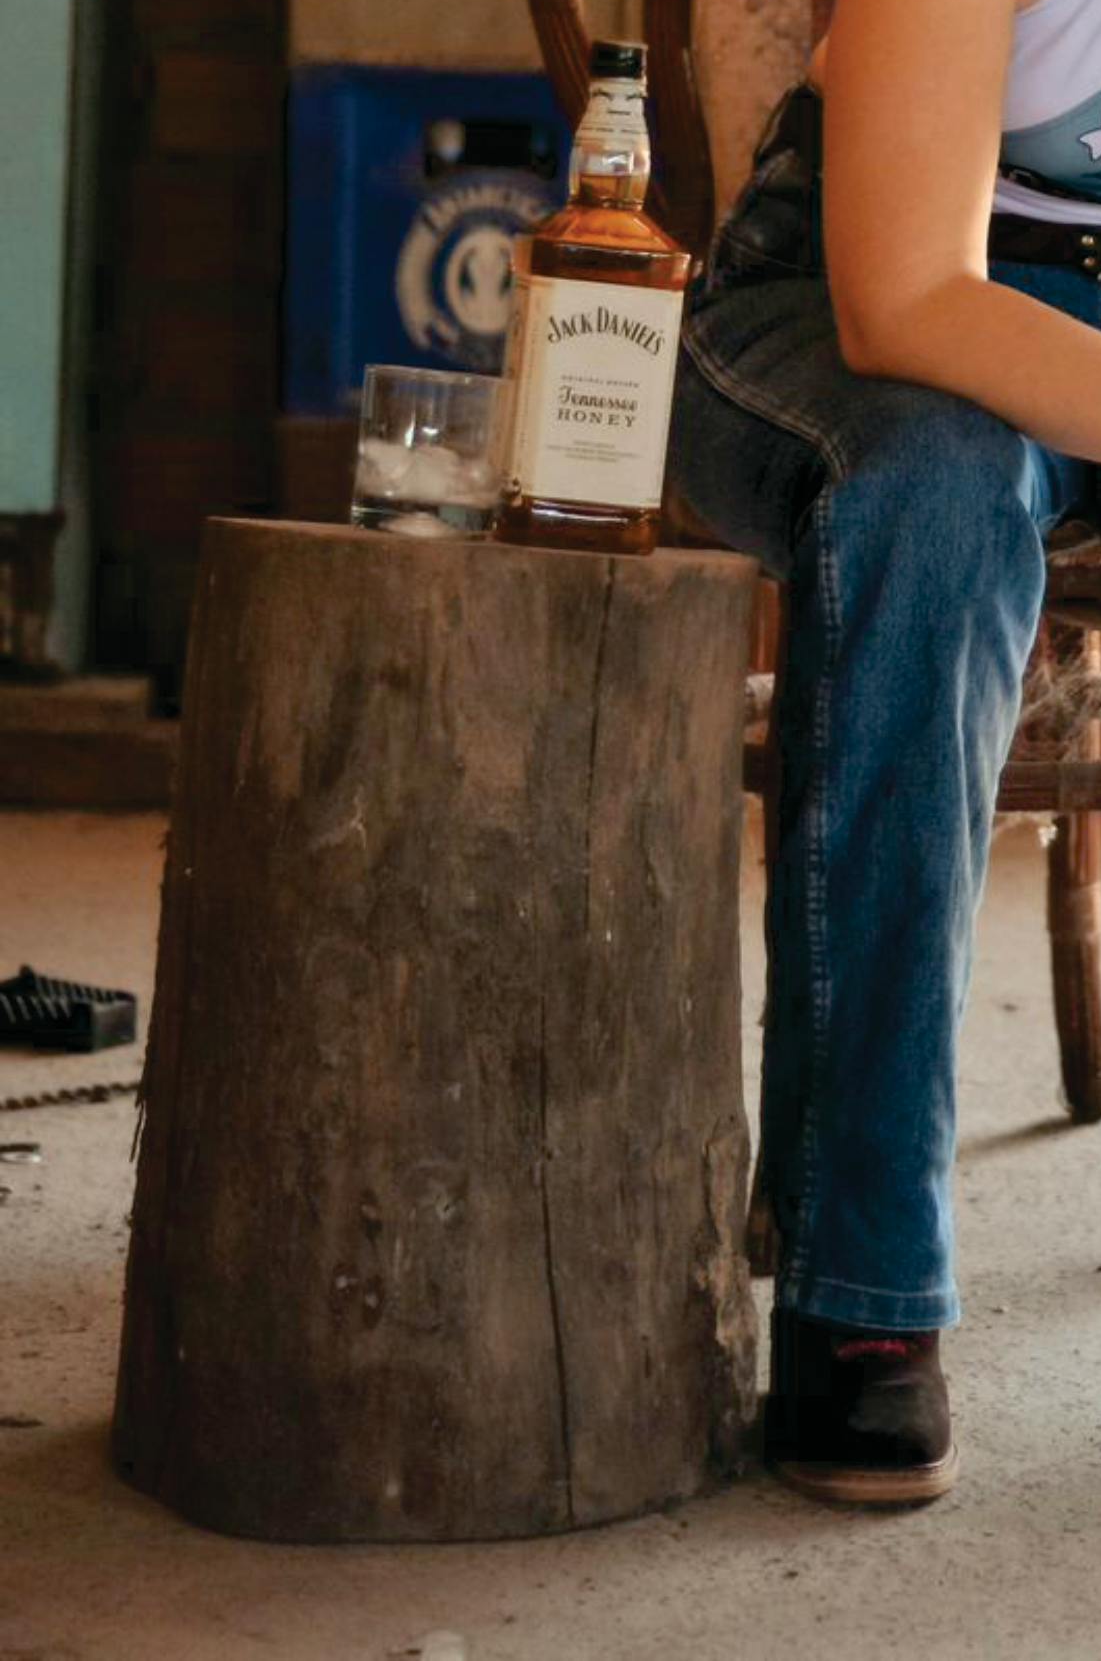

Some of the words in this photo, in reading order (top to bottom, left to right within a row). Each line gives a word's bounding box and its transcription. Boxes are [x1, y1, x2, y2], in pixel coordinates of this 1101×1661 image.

[547, 313, 593, 344] JACK
[596, 305, 665, 357] DANIEL'S
[558, 384, 638, 412] Tennessee
[557, 407, 636, 428] HONEY
